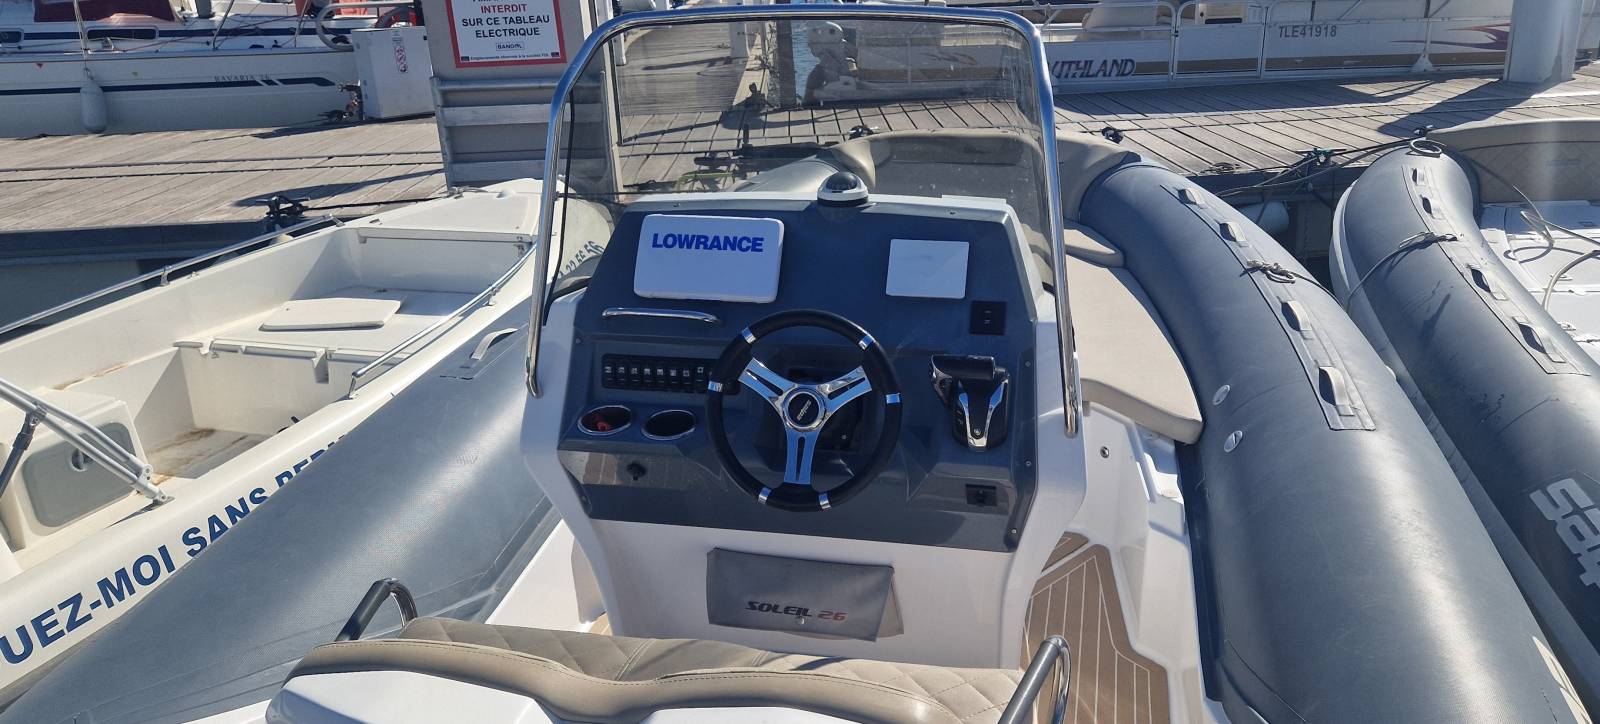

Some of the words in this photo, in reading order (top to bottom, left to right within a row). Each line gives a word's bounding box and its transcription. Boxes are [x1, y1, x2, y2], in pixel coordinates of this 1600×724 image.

[481, 4, 527, 13] INTERDIT
[462, 17, 483, 27] SUR
[486, 17, 500, 26] CE
[503, 15, 550, 25] TABLEAU
[475, 27, 541, 38] ELECTRIQUE
[1279, 25, 1337, 38] TLE41918
[652, 233, 764, 253] LOWRANCE
[0, 544, 176, 665] UEZ-MOI
[181, 487, 268, 558] SANS
[744, 600, 812, 618] SOLEIL
[817, 610, 848, 622] 26
